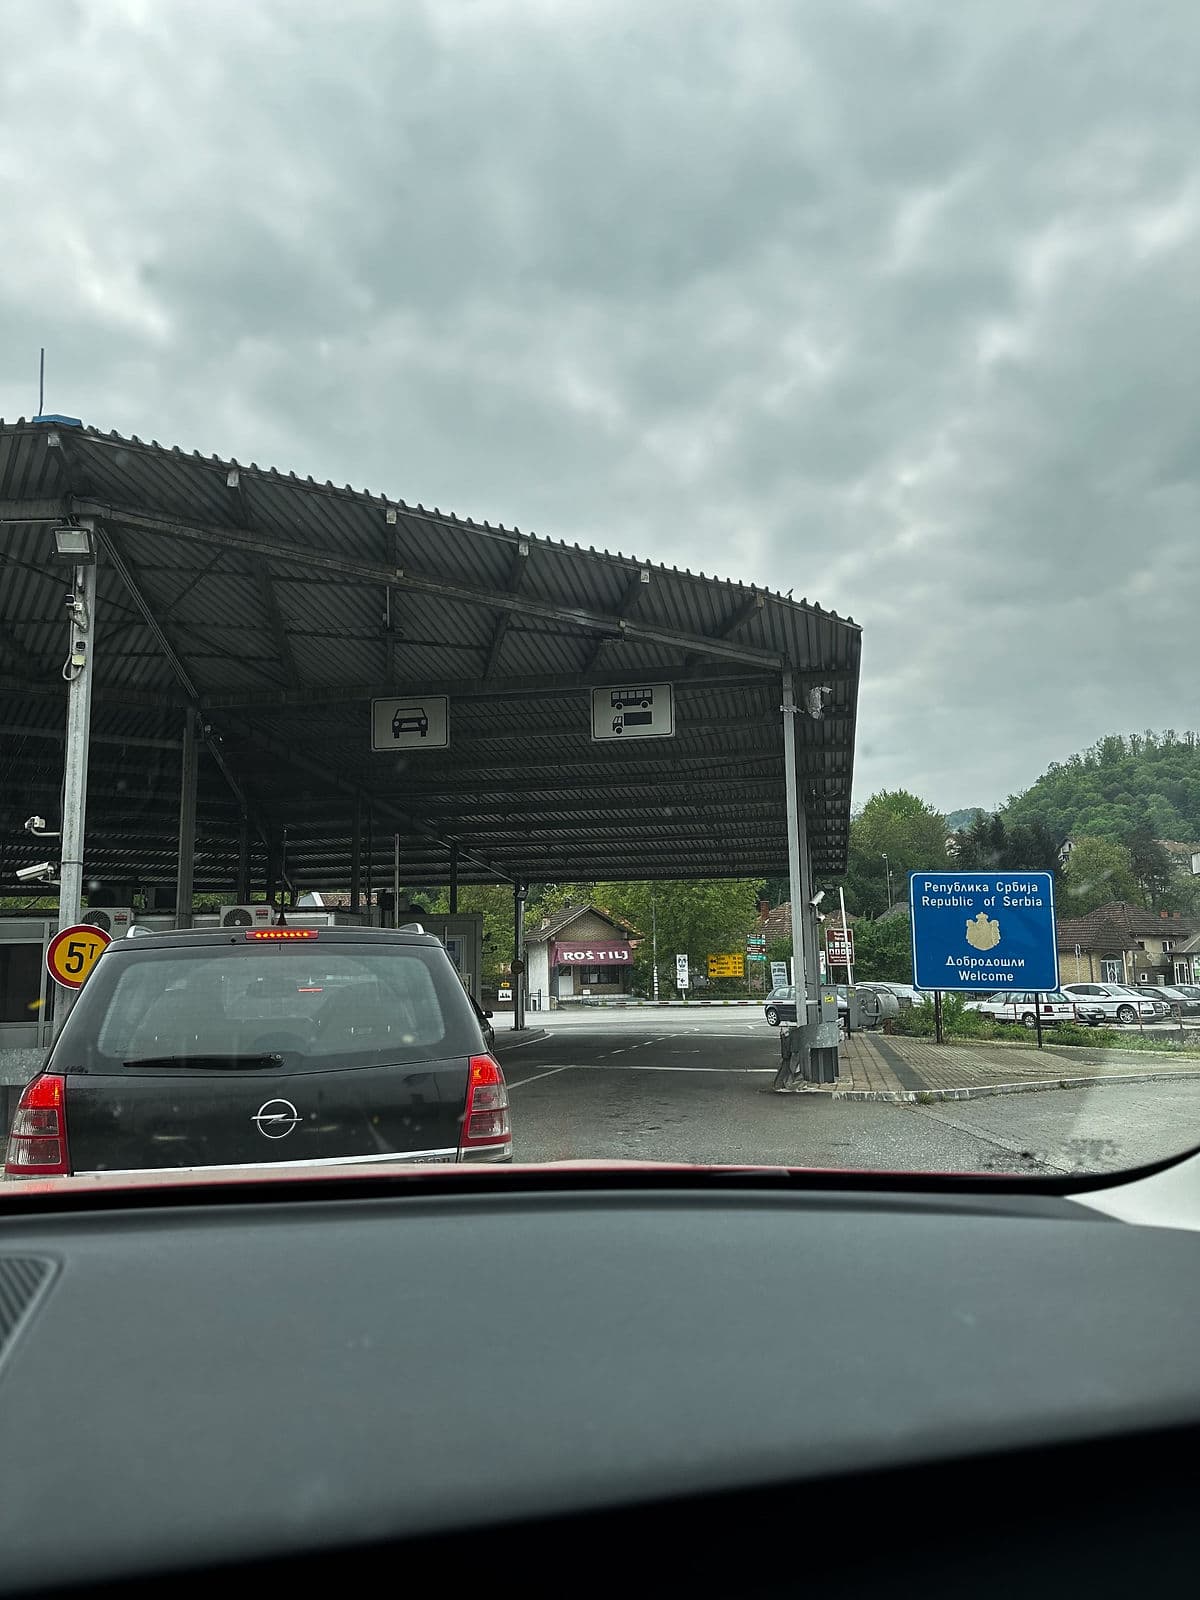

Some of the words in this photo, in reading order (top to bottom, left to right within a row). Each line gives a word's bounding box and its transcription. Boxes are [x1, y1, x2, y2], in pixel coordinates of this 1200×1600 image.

[924, 881, 989, 894] Република
[996, 881, 1038, 894] Србија
[922, 896, 974, 908] Republic
[983, 896, 996, 907] of
[1003, 896, 1043, 907] Serbia
[945, 955, 1025, 968] Добродошли
[958, 970, 1014, 982] Welcome
